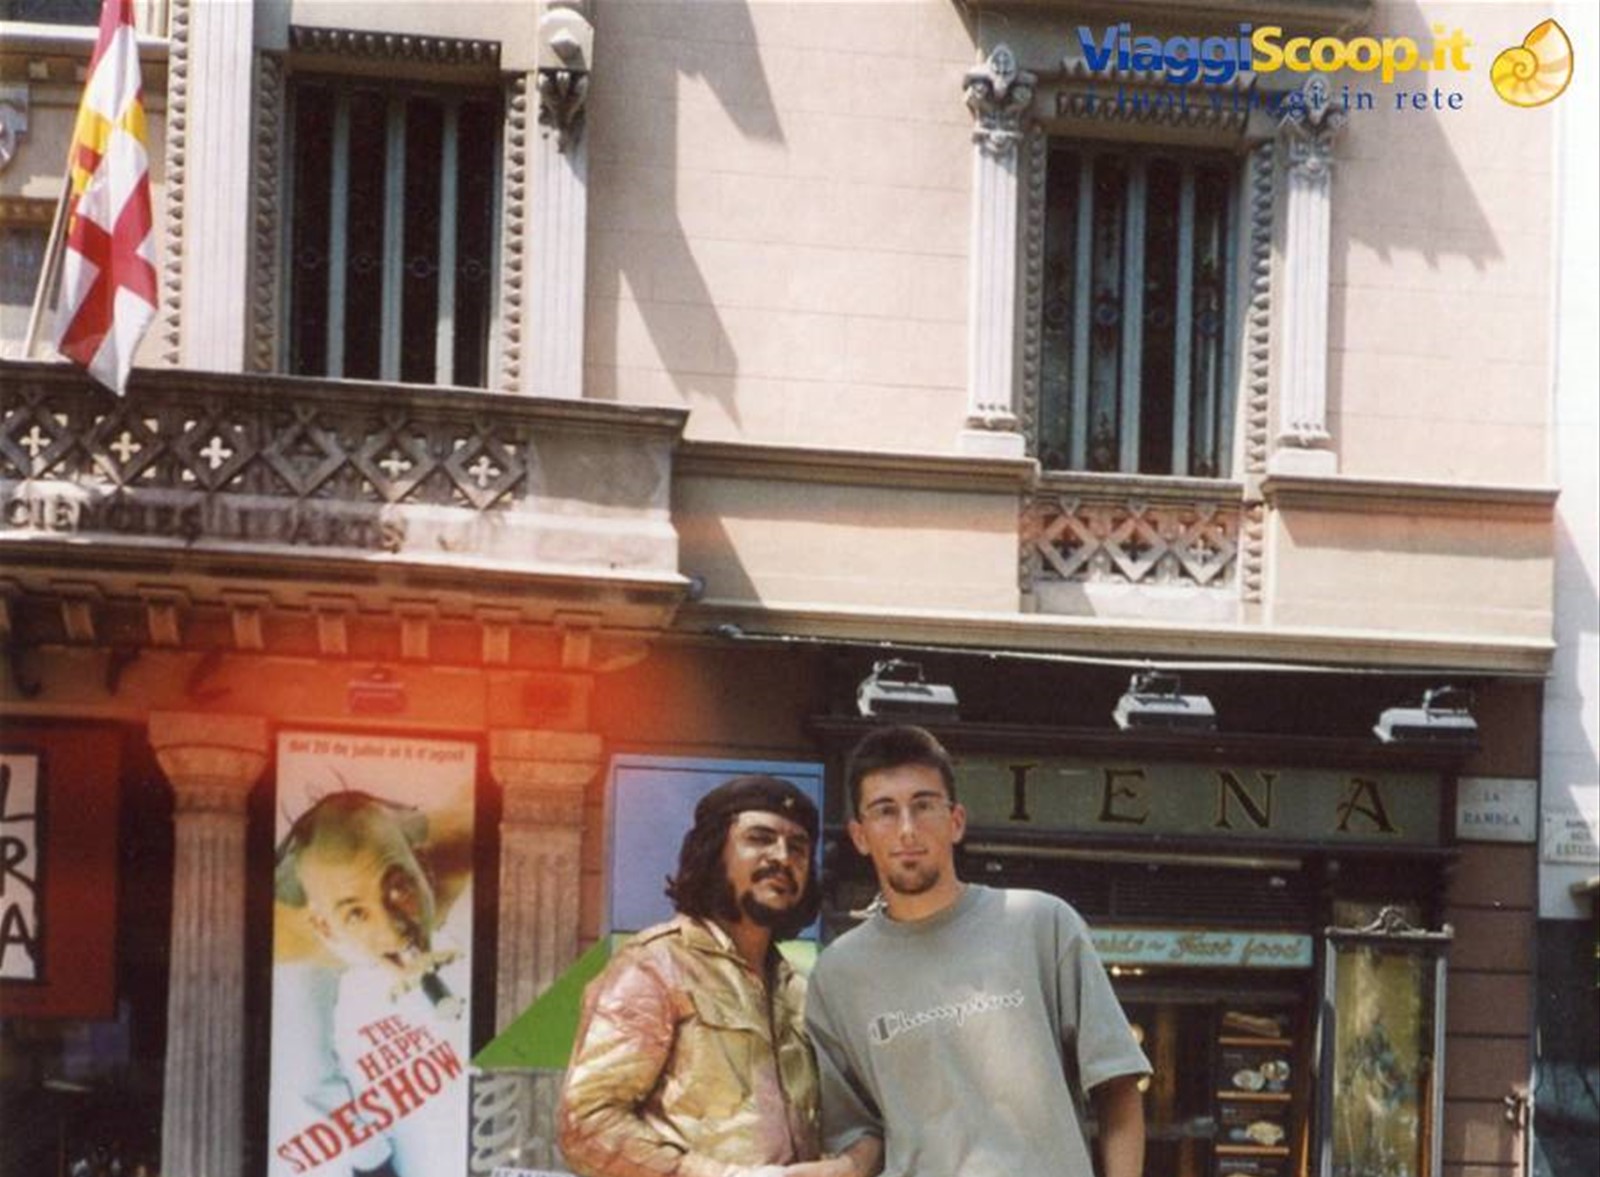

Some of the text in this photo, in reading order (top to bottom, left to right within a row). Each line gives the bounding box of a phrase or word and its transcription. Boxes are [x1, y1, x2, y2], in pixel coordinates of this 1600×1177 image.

[1009, 763, 1401, 834] IENA
[1240, 936, 1303, 967] food
[357, 1024, 436, 1083] HAPPY
[358, 1013, 411, 1046] THE
[277, 1040, 463, 1174] SIDESHOW
